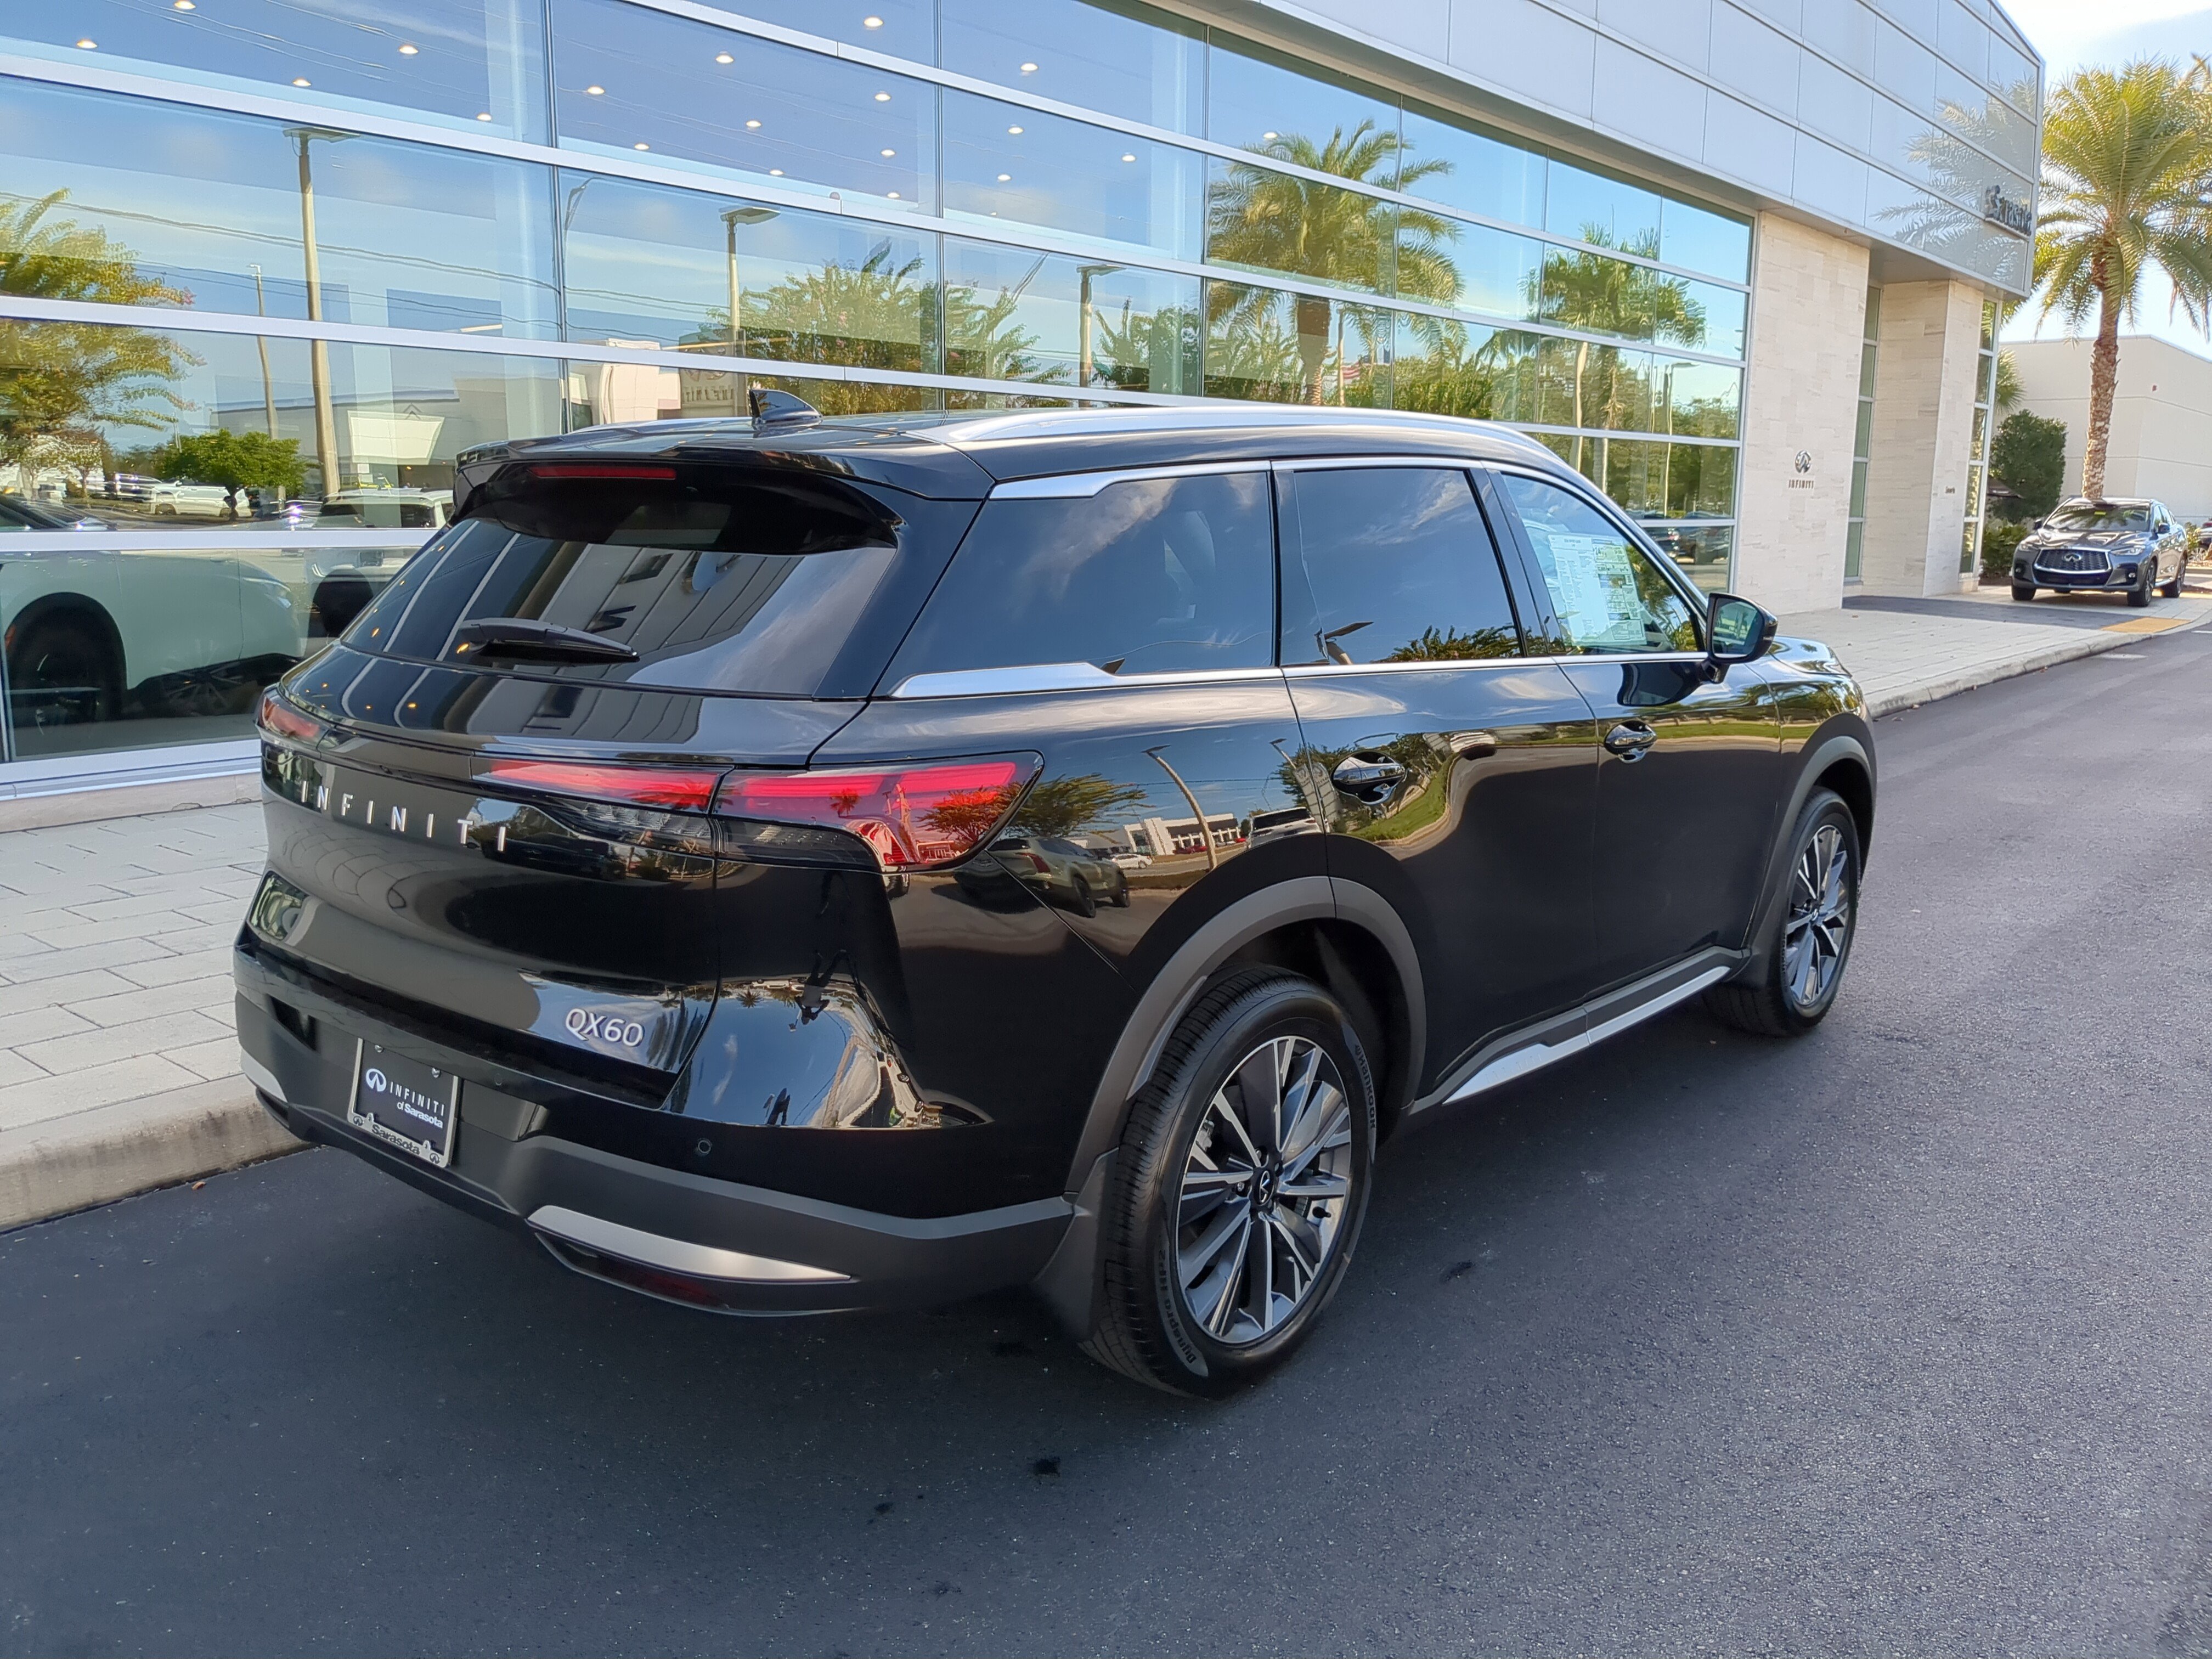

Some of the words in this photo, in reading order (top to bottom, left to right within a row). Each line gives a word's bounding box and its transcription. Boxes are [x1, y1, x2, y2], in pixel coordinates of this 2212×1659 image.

[1788, 479, 1814, 489] INFINITI
[300, 780, 507, 853] INFINITI
[565, 1008, 645, 1047] QX60
[390, 1081, 444, 1116] INFINITI
[397, 1101, 404, 1109] of
[404, 1103, 443, 1128] Sarasota
[371, 1124, 420, 1155] Sarasota
